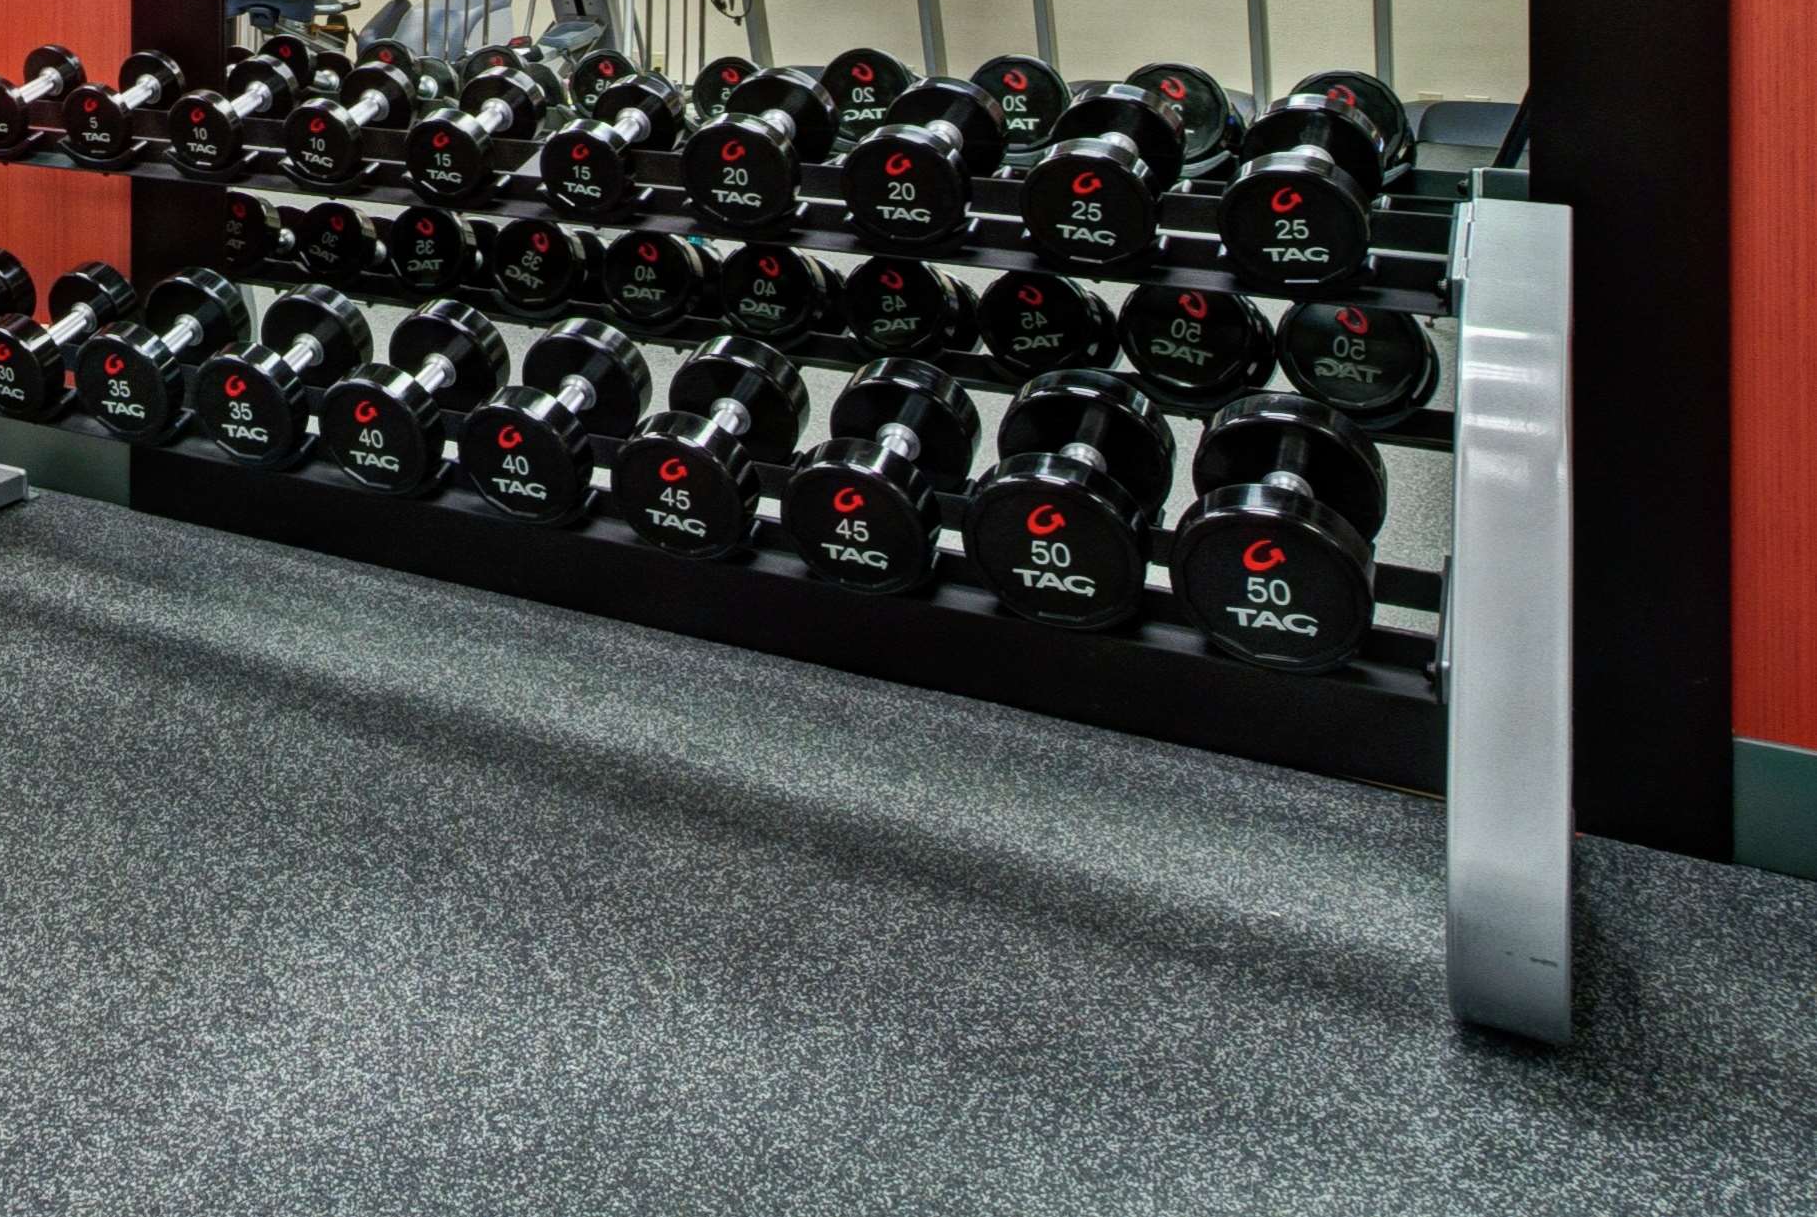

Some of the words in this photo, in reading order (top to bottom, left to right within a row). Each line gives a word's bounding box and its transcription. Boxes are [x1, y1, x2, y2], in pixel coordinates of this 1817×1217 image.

[89, 116, 98, 129] 5
[83, 132, 110, 143] TAG
[192, 127, 207, 140] 10
[186, 143, 217, 155] TAG
[310, 137, 325, 151] 10
[300, 151, 333, 168] TAG
[434, 153, 451, 168] 15
[426, 169, 463, 184] TAG
[573, 165, 591, 180] 15
[723, 167, 748, 186] 20
[563, 182, 601, 198] TAG
[711, 190, 762, 208] TAG
[888, 182, 915, 201] 20
[877, 206, 931, 224] TAG
[1071, 201, 1102, 222] 25
[1056, 224, 1116, 246] TAG
[1275, 219, 1310, 240] 25
[1263, 247, 1329, 263] TAG
[108, 379, 131, 398] 35
[101, 400, 146, 419] TAG
[228, 401, 253, 421] 35
[221, 423, 269, 443] TAG
[358, 428, 383, 449] 40
[349, 450, 400, 473] TAG
[502, 454, 529, 476] 40
[491, 477, 547, 500] TAG
[659, 487, 691, 511] 45
[645, 508, 707, 537] TAG
[835, 518, 870, 542] 45
[821, 543, 889, 570] TAG
[1030, 540, 1072, 568] 50
[1012, 568, 1096, 598] TAG
[1246, 578, 1292, 606] 50
[1226, 606, 1319, 637] TAG
